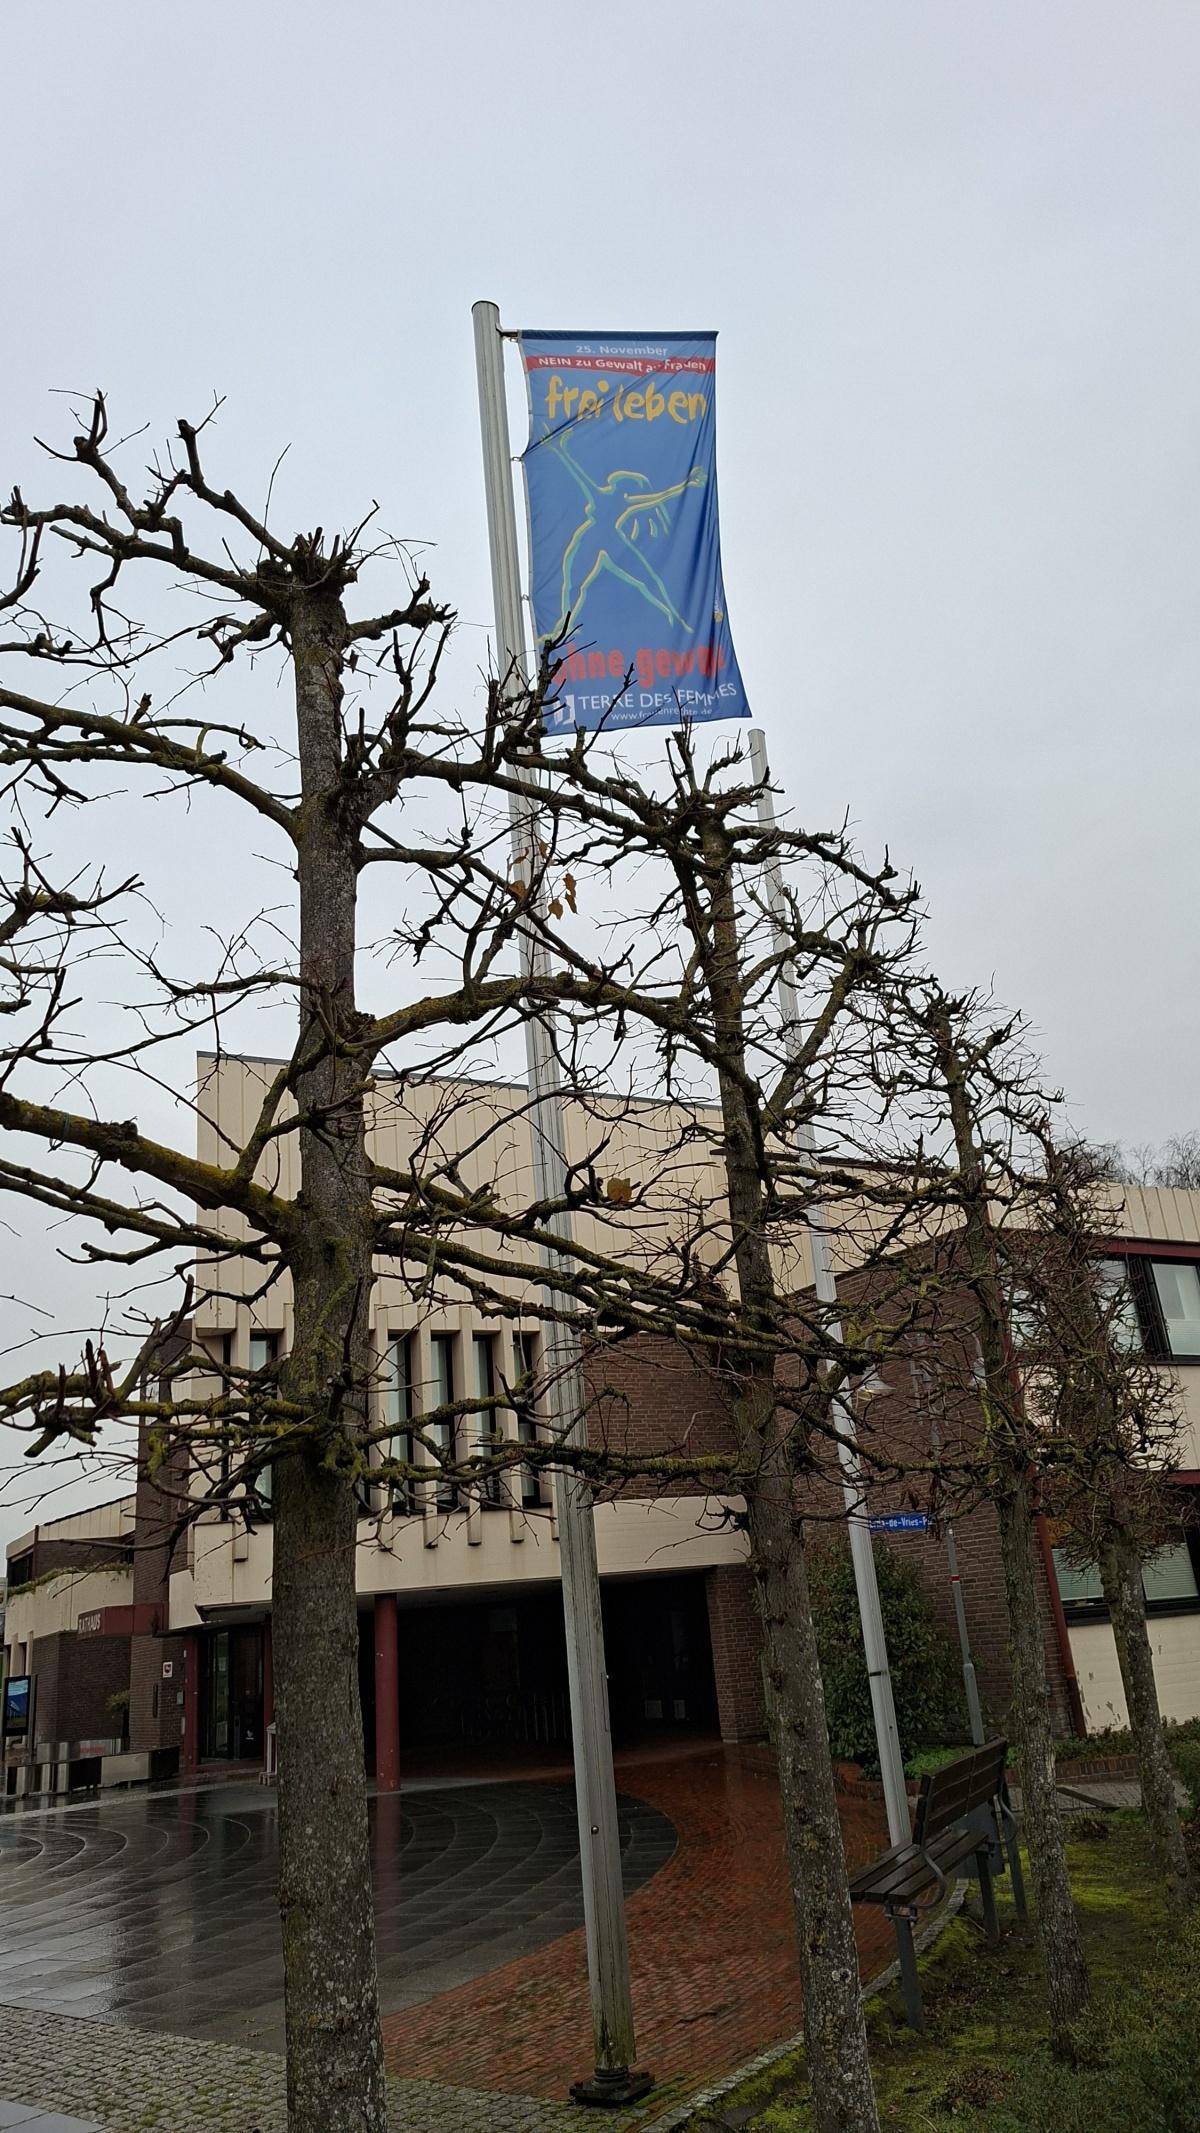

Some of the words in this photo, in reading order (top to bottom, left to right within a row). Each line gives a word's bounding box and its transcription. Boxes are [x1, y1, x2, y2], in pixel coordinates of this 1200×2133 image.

[575, 345, 595, 355] 25.
[600, 345, 668, 356] November
[538, 357, 571, 367] NEIN
[576, 359, 591, 368] zu
[595, 359, 643, 372] Gewalt
[612, 381, 707, 424] leben
[636, 643, 726, 688] gewat
[640, 692, 672, 708] DES
[677, 682, 738, 706] FEMMES
